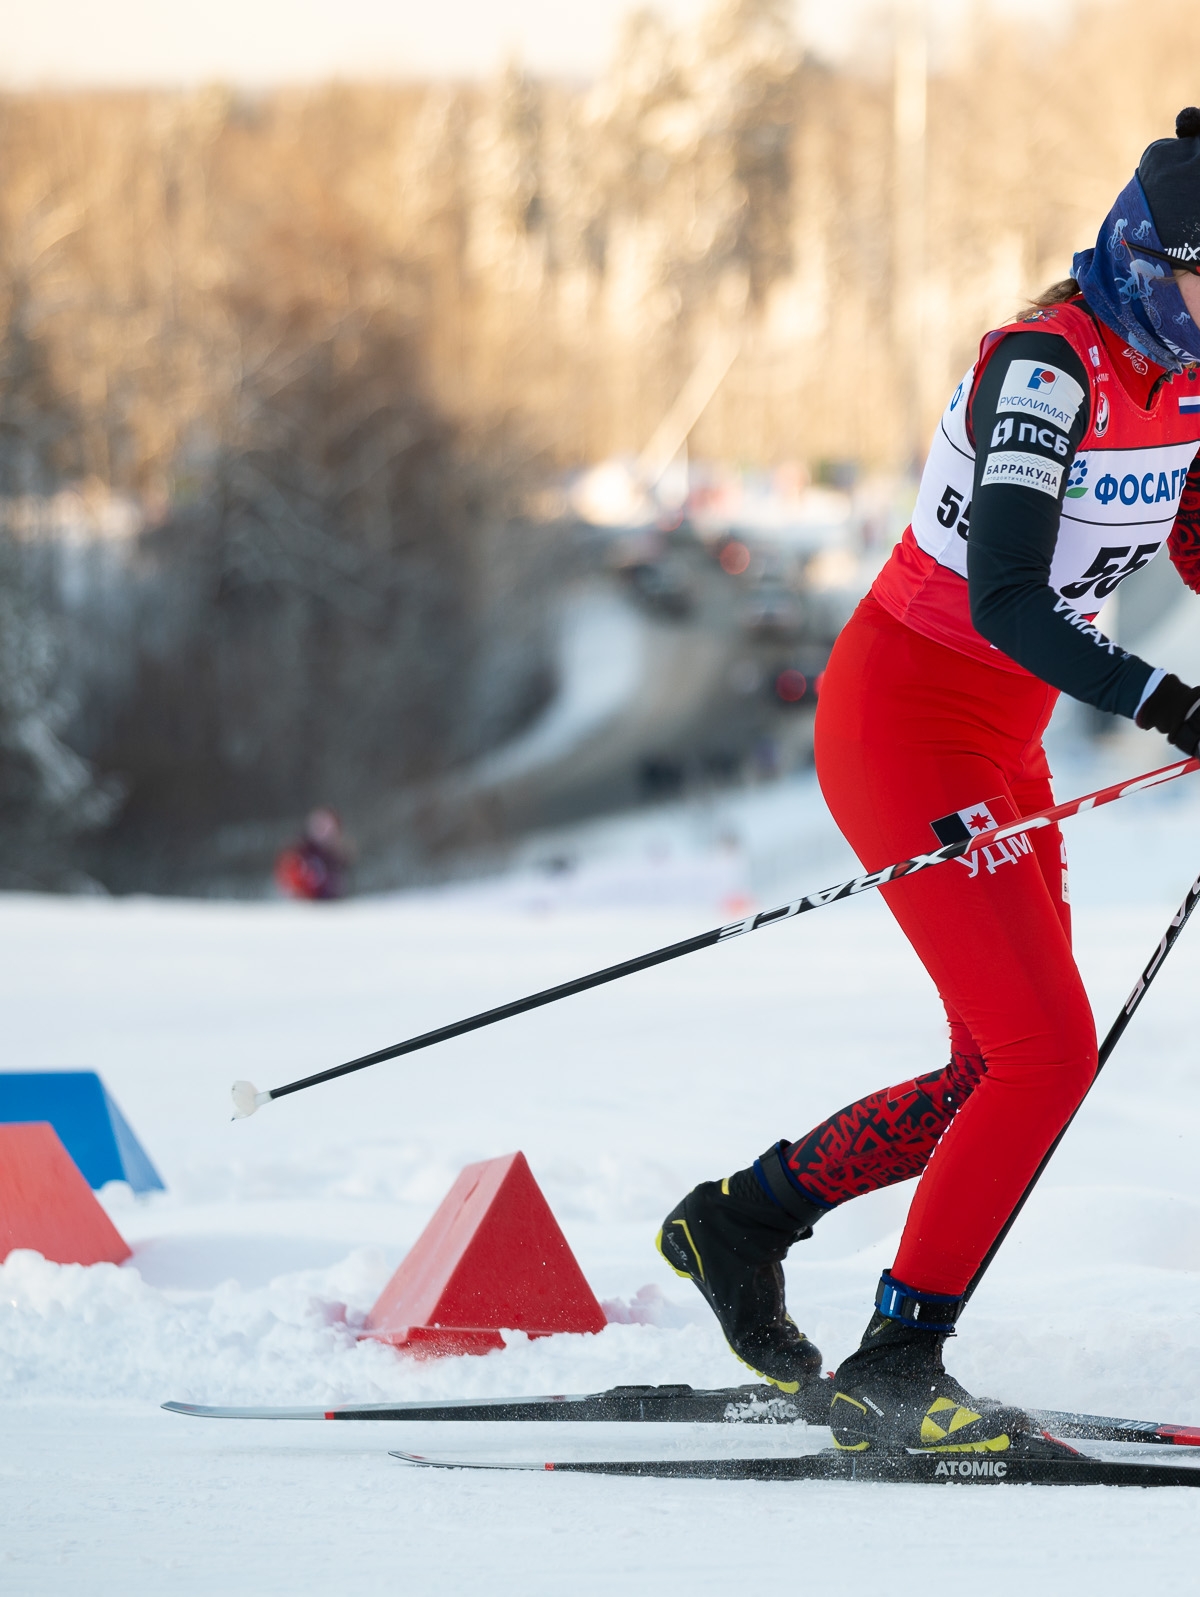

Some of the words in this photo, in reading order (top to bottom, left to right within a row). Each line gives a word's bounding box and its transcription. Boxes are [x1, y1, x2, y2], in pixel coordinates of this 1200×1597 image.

[1000, 396, 1071, 424] РУСКЛИМАТ
[1019, 422, 1070, 456] ПСБ
[986, 464, 1057, 487] БАРРАКУДА
[1059, 541, 1163, 600] 55
[1052, 597, 1120, 655] VMAX
[953, 832, 1034, 879] УДМ
[934, 1460, 1008, 1478] ATOMIC
